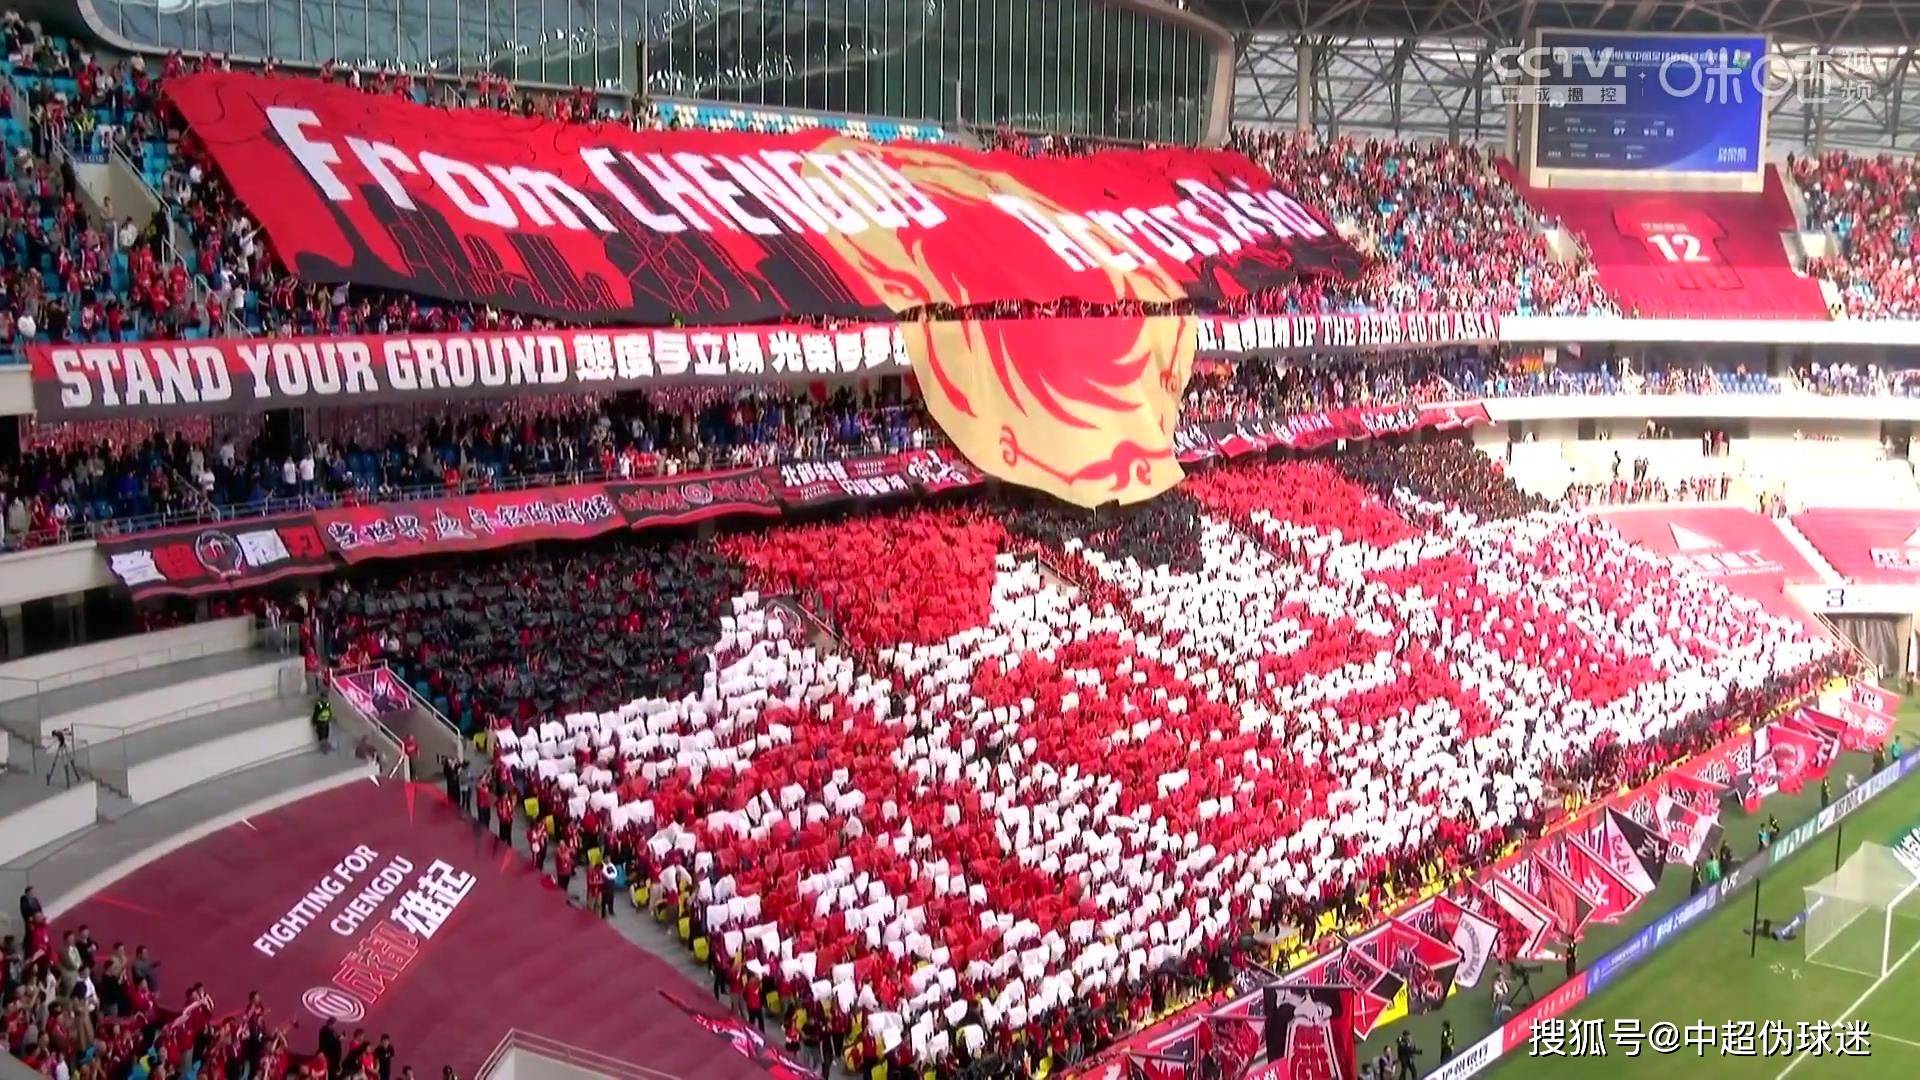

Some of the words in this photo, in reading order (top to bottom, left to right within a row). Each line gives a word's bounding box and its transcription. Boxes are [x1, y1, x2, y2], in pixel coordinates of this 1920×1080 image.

[265, 106, 619, 234] From
[579, 146, 948, 236] CHENGDU
[1647, 233, 1711, 262] 12
[1293, 316, 1318, 347] UP
[1320, 314, 1358, 346] THE
[51, 346, 232, 408] STAND
[236, 341, 379, 399] YOUR
[383, 334, 568, 390] GROUND
[253, 875, 345, 957] FIGHTING
[333, 844, 379, 883] FOR
[330, 855, 415, 937] CHENGDU
